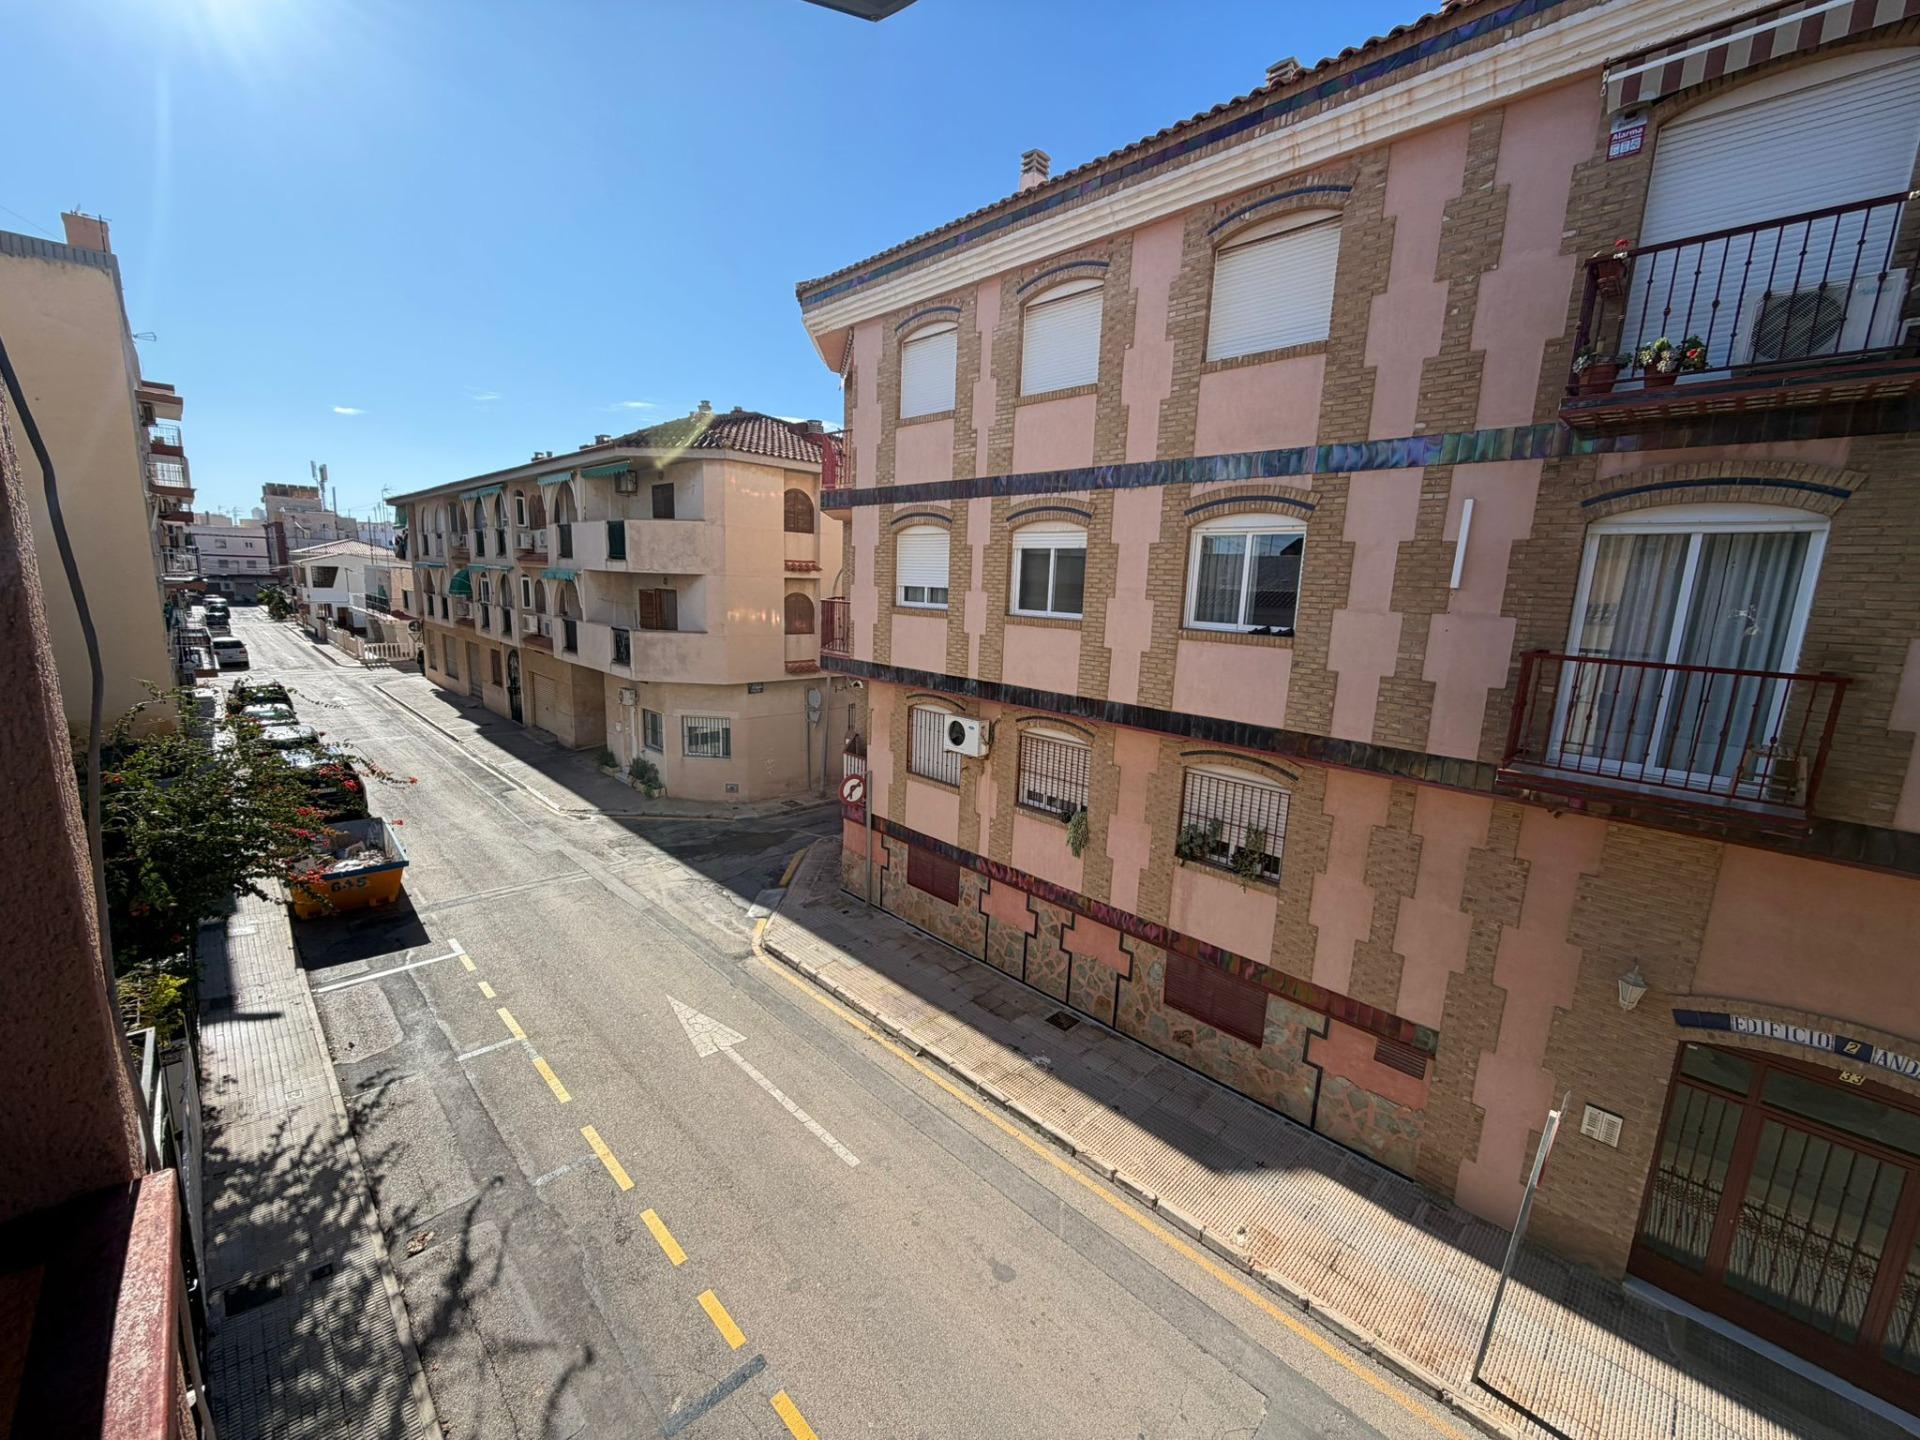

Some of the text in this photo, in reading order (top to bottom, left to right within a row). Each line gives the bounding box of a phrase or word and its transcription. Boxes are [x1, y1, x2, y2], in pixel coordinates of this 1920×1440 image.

[1612, 126, 1643, 141] Alarma
[1735, 1016, 1830, 1047] EDIFICIO
[1876, 1051, 1920, 1077] AND
[1840, 1070, 1864, 1084] 33
